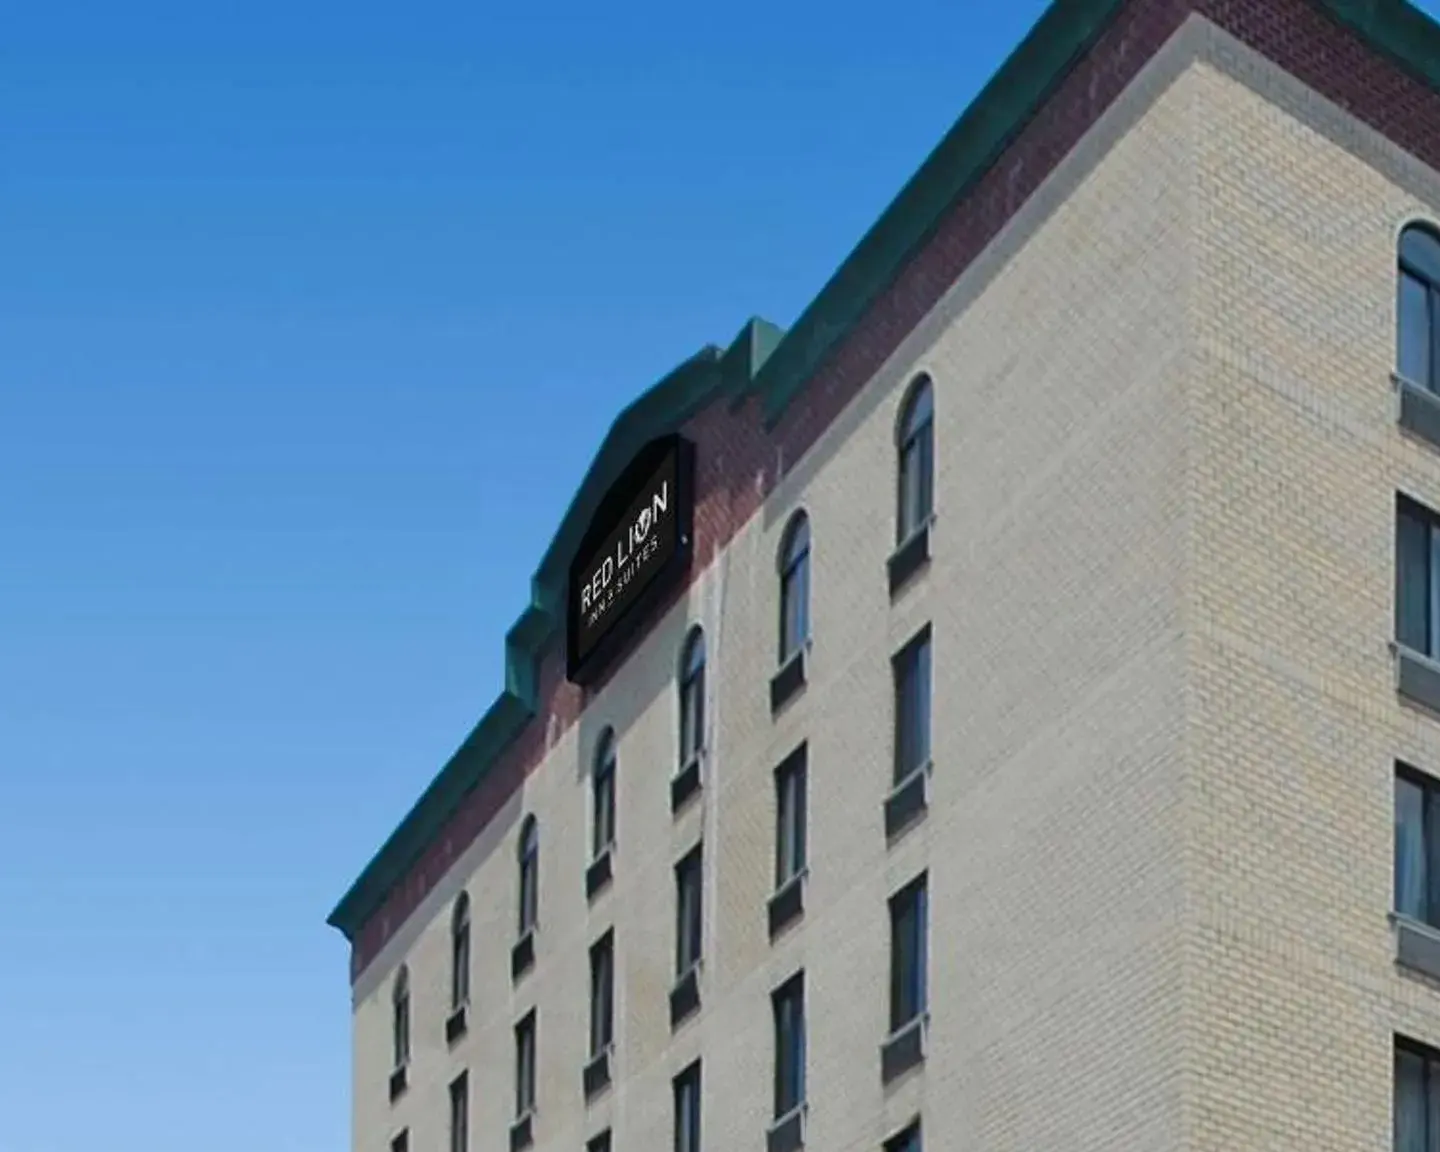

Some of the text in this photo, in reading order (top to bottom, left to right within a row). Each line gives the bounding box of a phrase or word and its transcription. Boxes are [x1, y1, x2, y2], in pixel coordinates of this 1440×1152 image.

[581, 480, 668, 615] RED LION
[617, 535, 658, 593] SUITES
